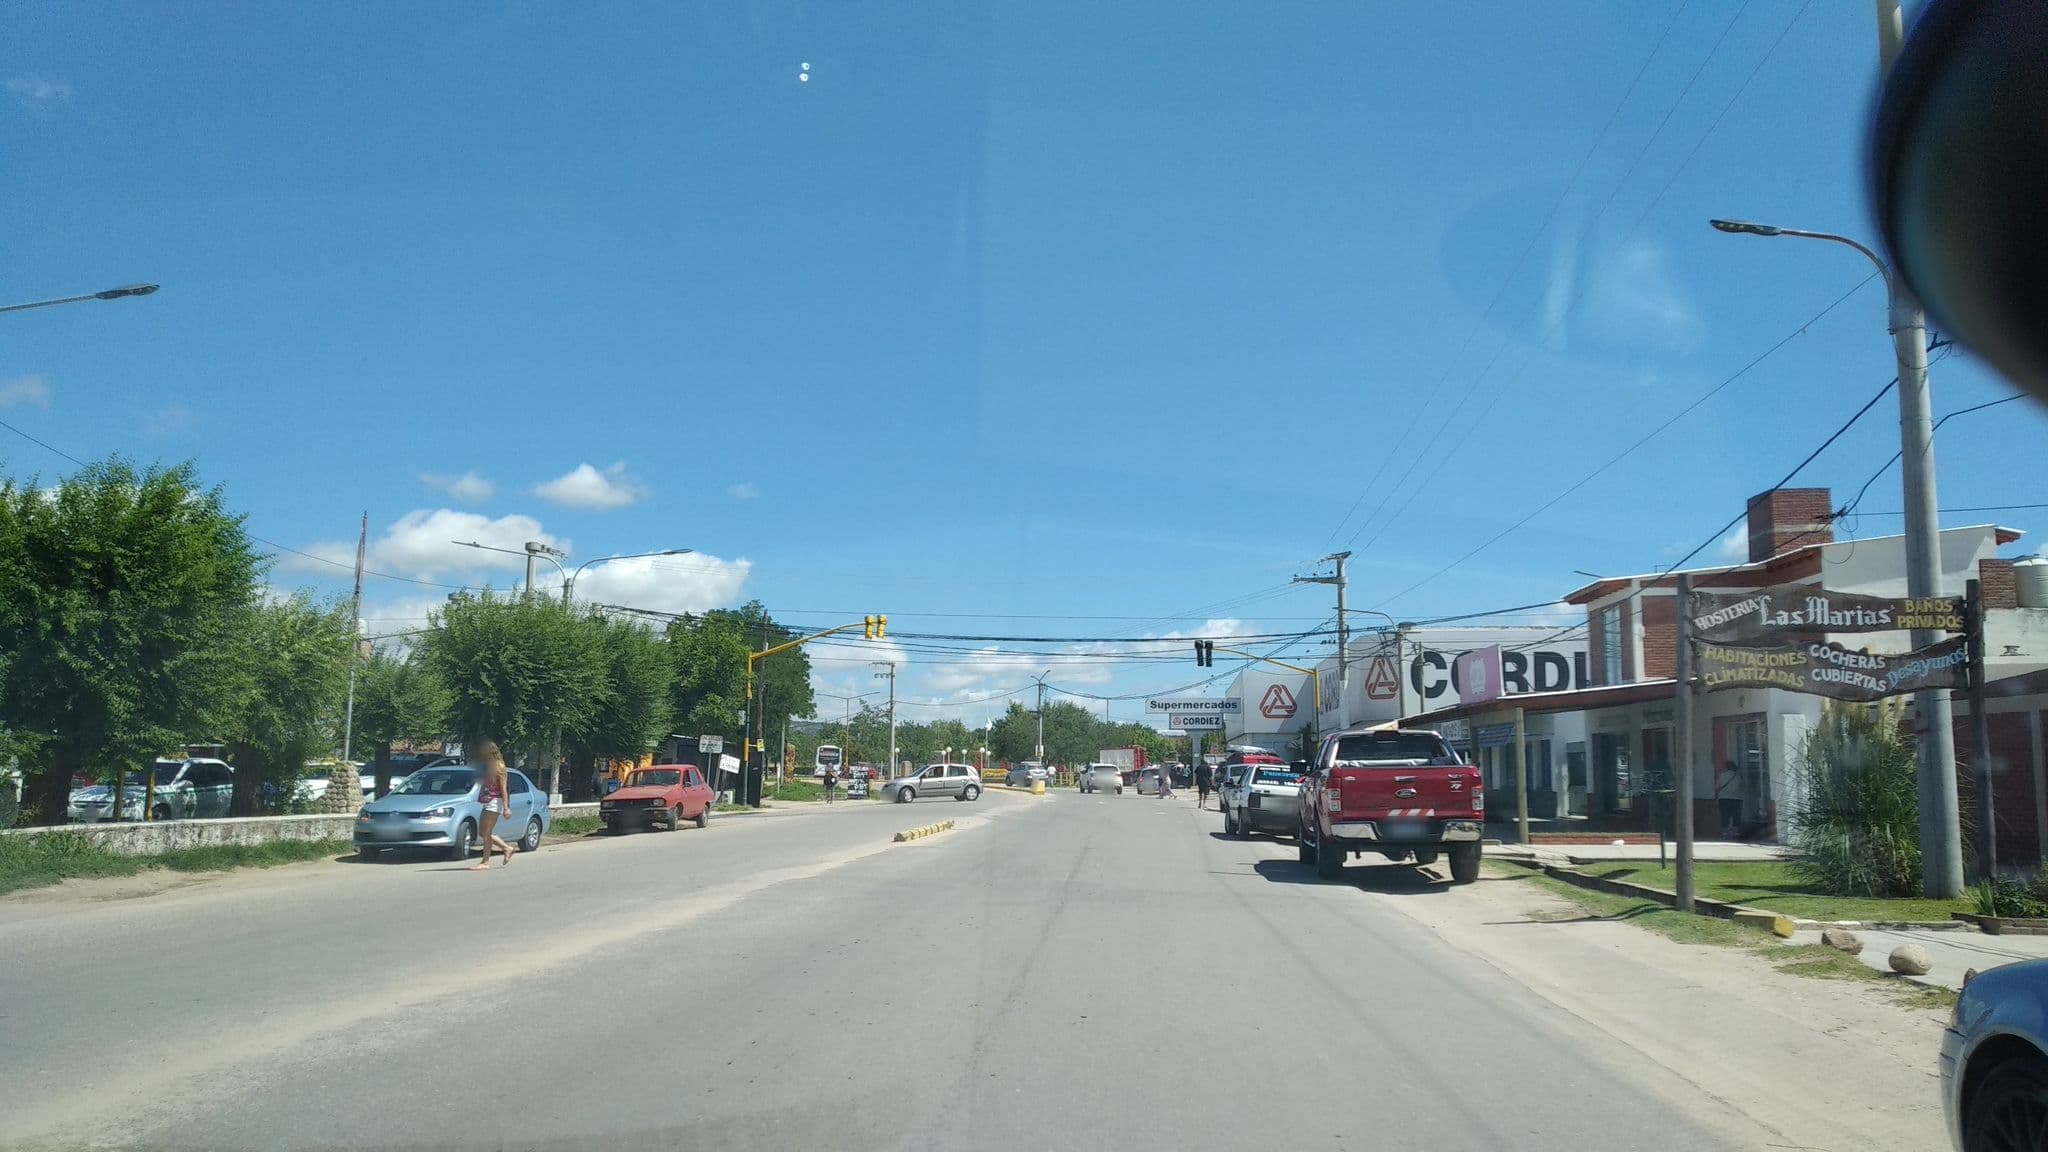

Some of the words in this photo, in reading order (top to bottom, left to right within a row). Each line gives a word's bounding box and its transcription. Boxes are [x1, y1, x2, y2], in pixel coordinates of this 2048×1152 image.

[1695, 599, 1760, 630] HOSTERIA
[1755, 595, 1805, 625] Las
[1807, 596, 1895, 625] Marias
[1897, 615, 1965, 629] PRIVADOS
[1809, 644, 1886, 669] COCHERAS
[1886, 647, 1965, 689] Desayunos
[1411, 651, 1587, 699] CRDI
[1812, 667, 1887, 692] CUBIERTAS
[1150, 700, 1238, 711] Supermercados
[1182, 717, 1220, 725] CORDIEZ
